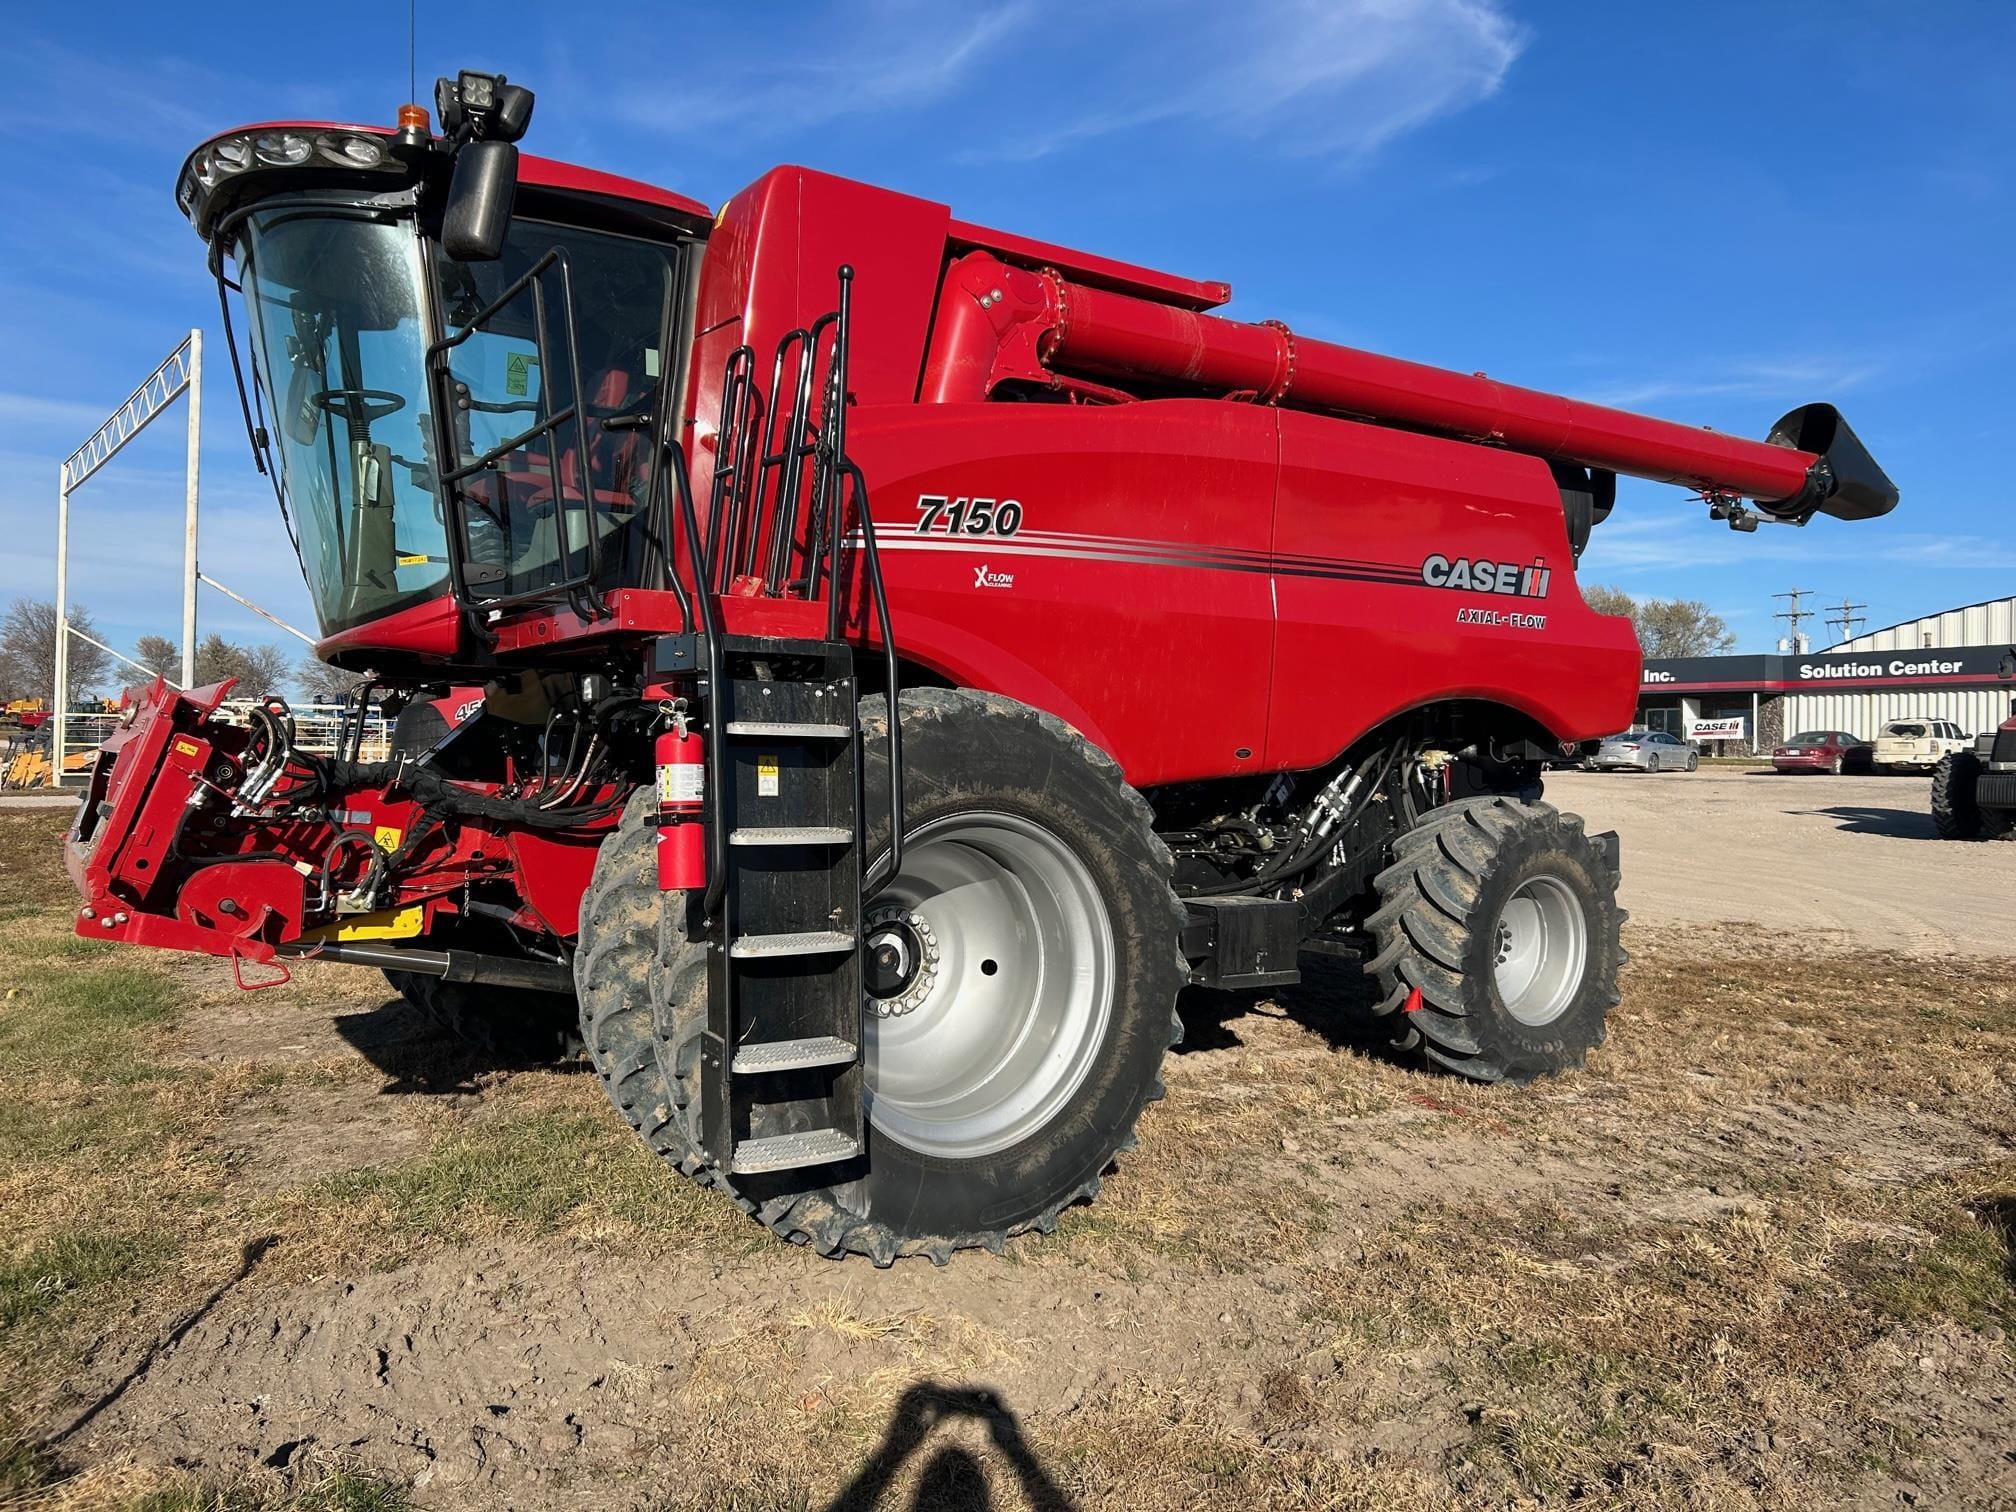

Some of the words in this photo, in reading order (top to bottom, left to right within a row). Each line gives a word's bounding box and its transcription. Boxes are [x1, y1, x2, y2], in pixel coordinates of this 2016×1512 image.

[915, 494, 1023, 537] 7150
[988, 573, 1014, 582] FLOW
[1421, 553, 1519, 594] CASE
[1456, 608, 1546, 629] AXIAL-FLOW
[1644, 669, 1675, 682] Inc.
[1800, 662, 1882, 679] Solution
[1889, 660, 1963, 675] Center
[1694, 723, 1727, 731] CASE
